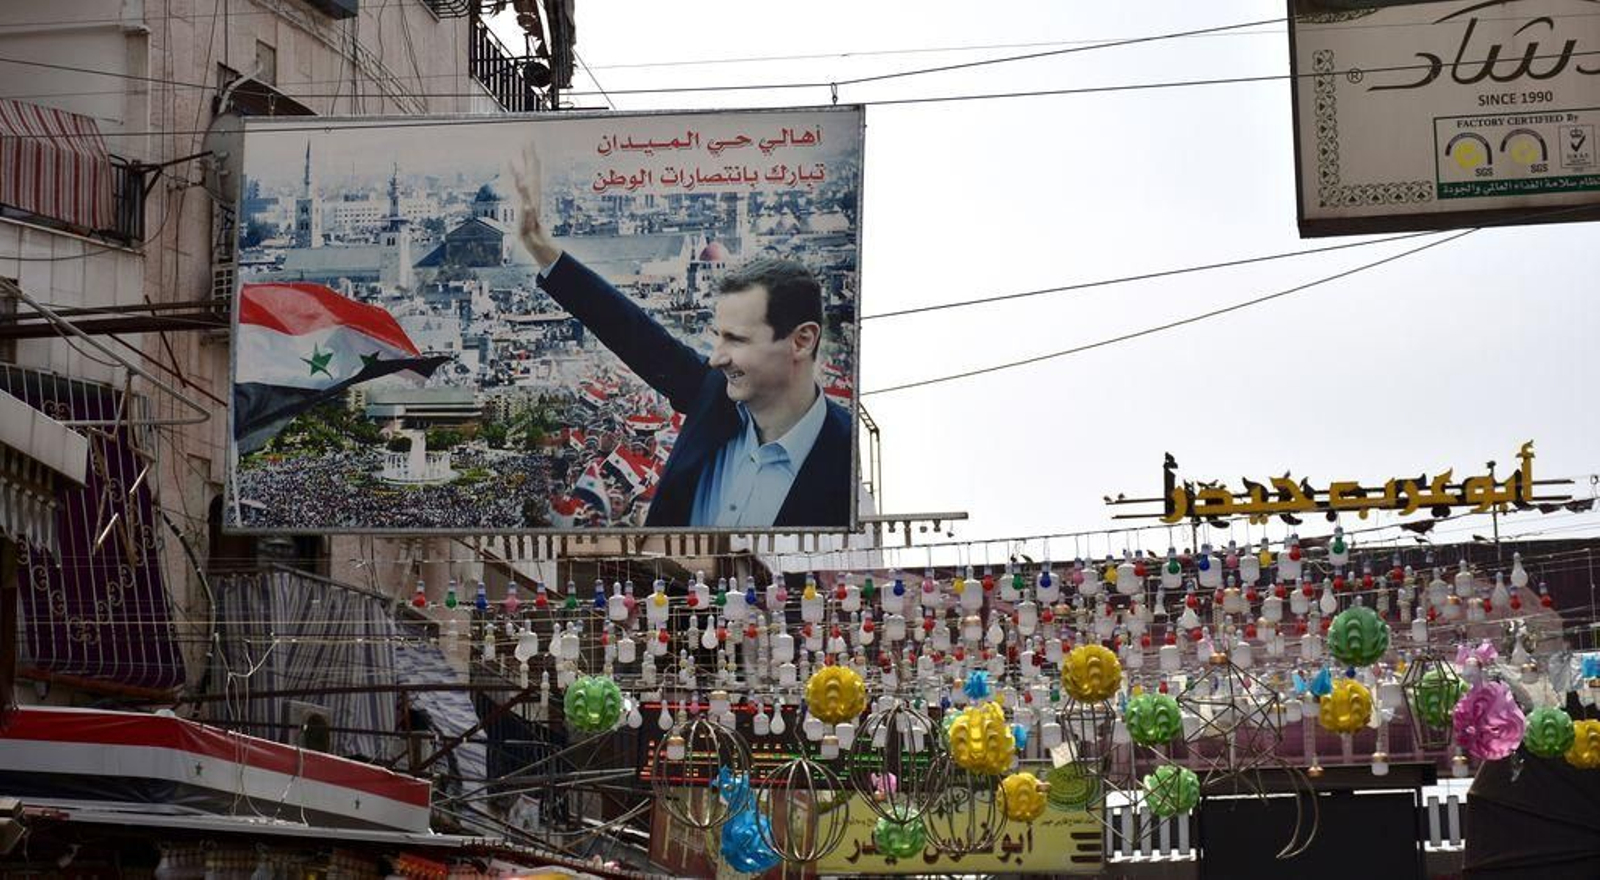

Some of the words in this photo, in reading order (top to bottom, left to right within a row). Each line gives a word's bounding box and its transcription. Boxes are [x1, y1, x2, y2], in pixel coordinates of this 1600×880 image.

[1478, 92, 1517, 107] SINCE
[1521, 90, 1554, 104] 1990
[1456, 117, 1505, 129] FACTORY
[1506, 113, 1564, 126] CERTIFIED
[596, 130, 699, 154] الميدان
[706, 132, 752, 155] حي
[758, 125, 822, 154] أهالي
[592, 168, 653, 192] الوطن
[659, 165, 759, 191] بانتصارات
[764, 163, 825, 192] تبارك
[1475, 167, 1494, 178] SGS
[1530, 163, 1549, 174] SGS
